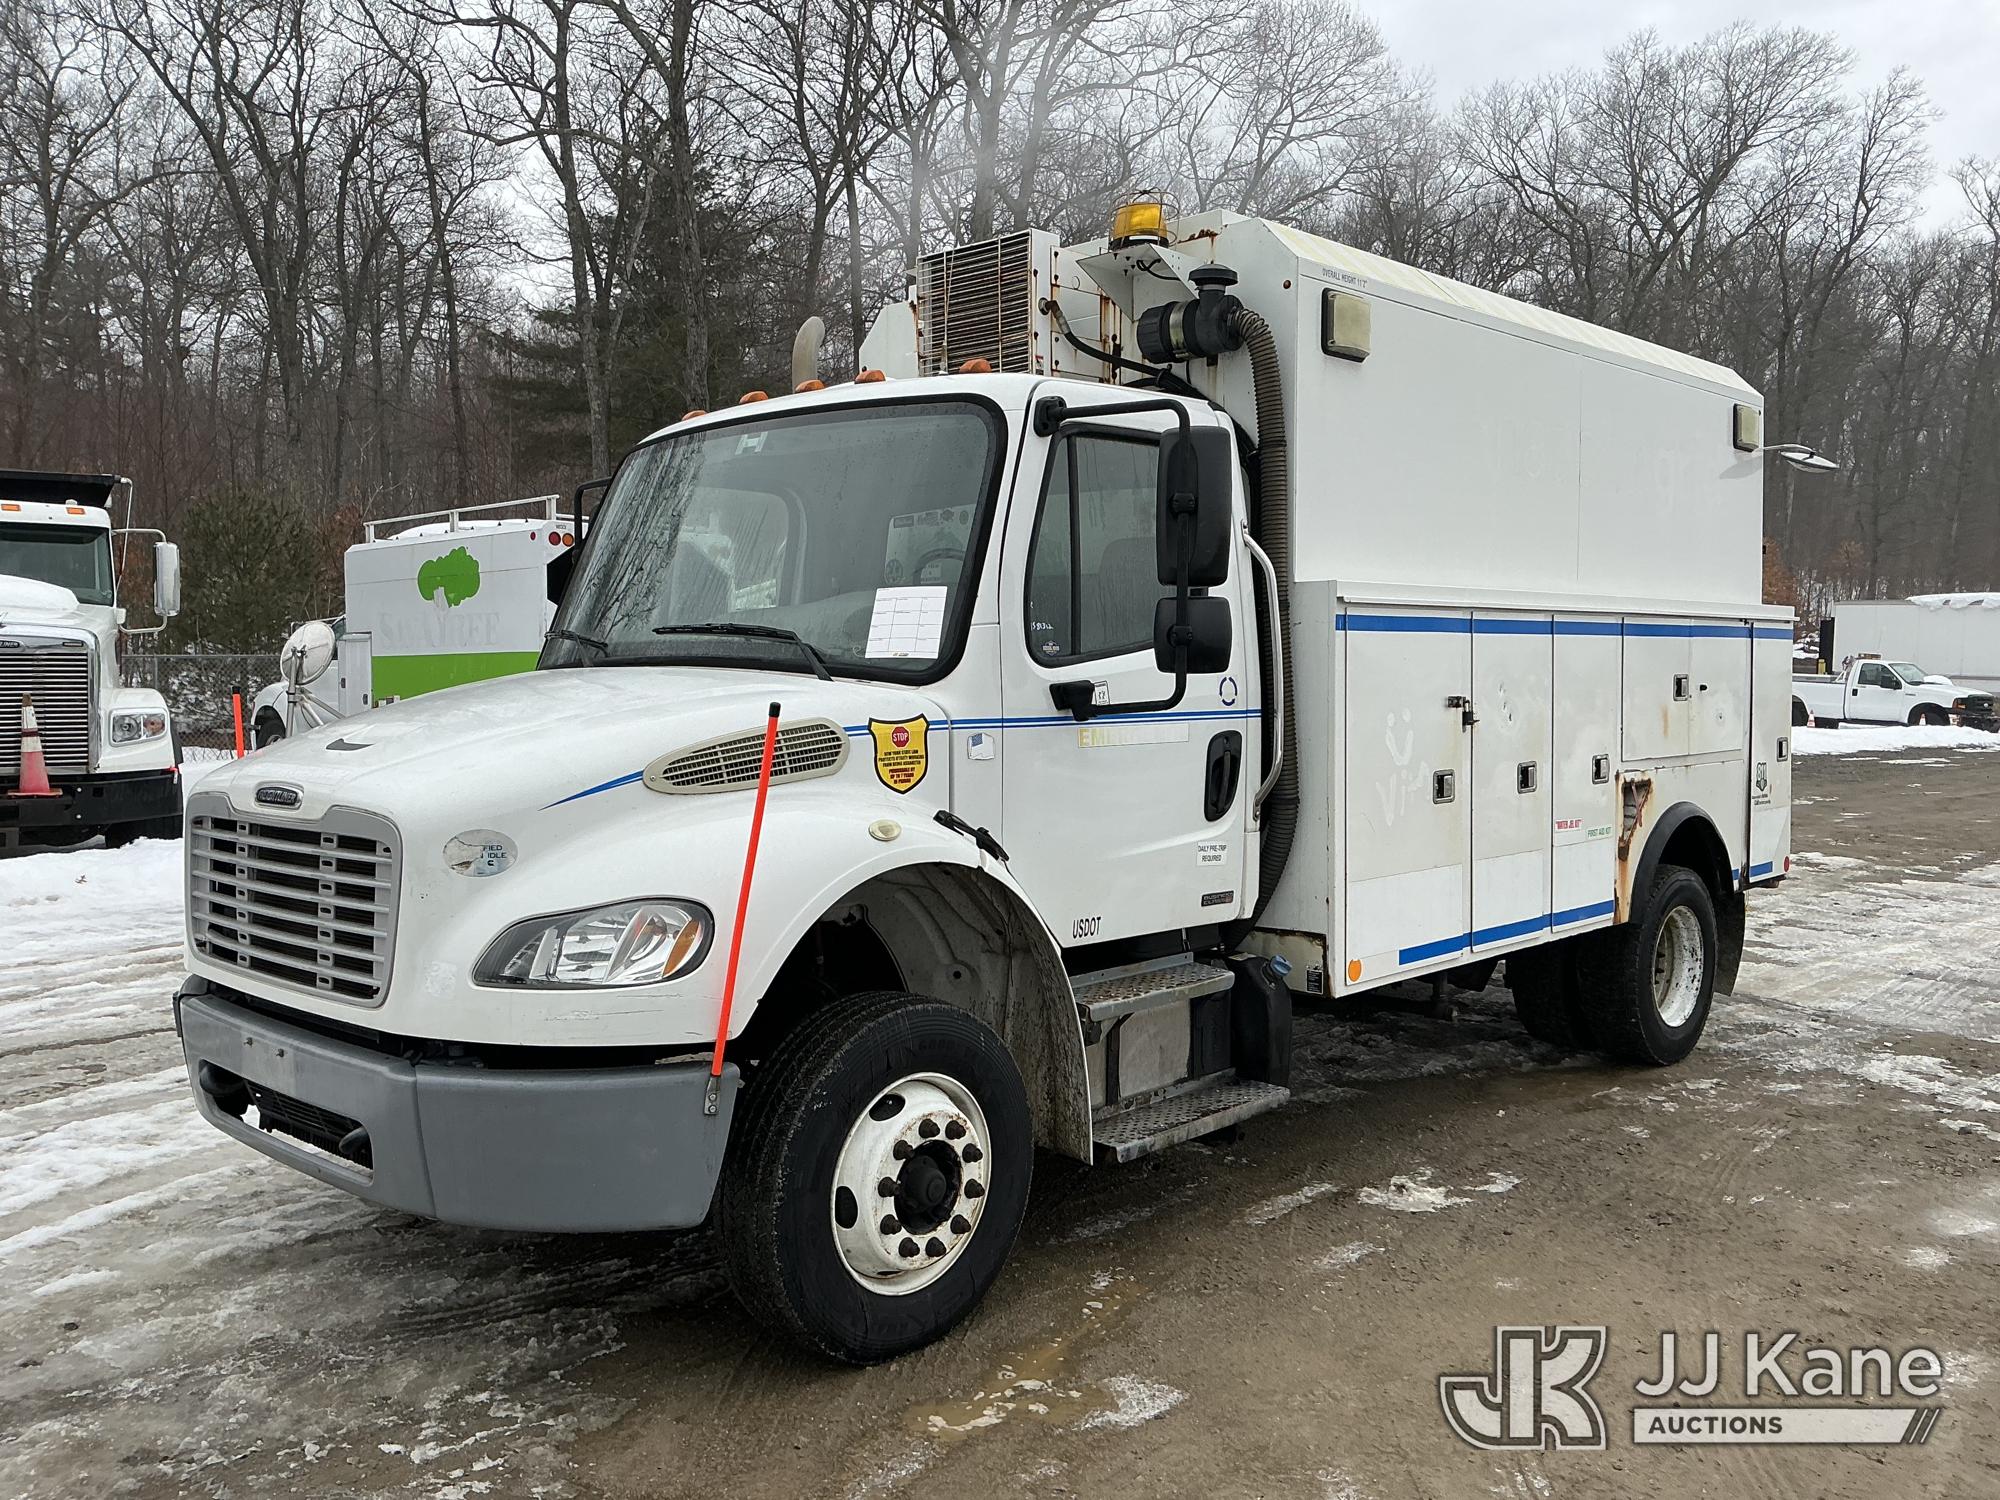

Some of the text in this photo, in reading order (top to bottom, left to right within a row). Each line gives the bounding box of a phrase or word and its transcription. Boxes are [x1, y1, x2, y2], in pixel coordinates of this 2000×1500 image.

[892, 732, 909, 742] STOP
[1201, 854, 1222, 862] REQUIRED
[1072, 916, 1102, 939] USDOT
